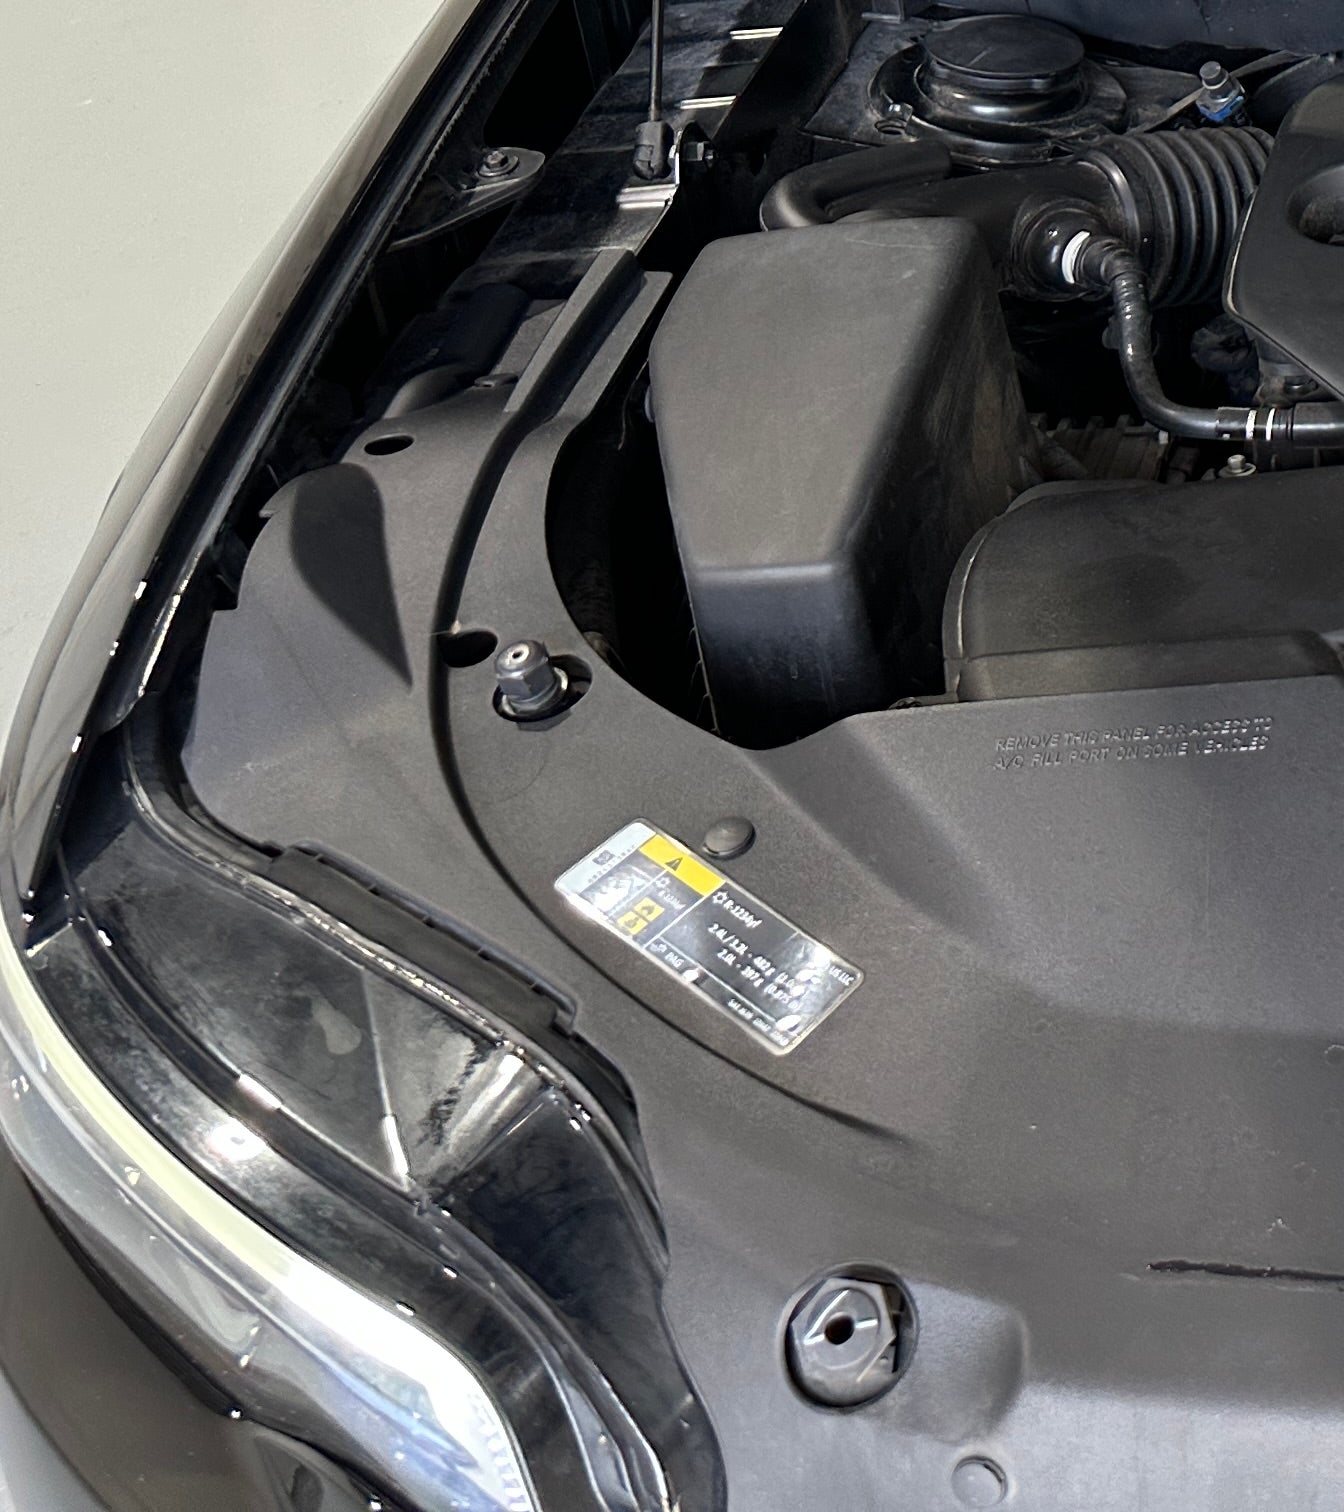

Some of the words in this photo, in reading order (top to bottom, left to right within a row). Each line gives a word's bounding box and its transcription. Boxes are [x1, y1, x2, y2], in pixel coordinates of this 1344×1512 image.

[995, 732, 1060, 751] REMOVE
[1064, 728, 1099, 745] THIS
[1103, 725, 1150, 742] PANEL
[1155, 723, 1187, 739] FOR
[1189, 718, 1251, 736] ACCESS
[1253, 716, 1273, 732] TO
[1030, 752, 1063, 768] FILL
[1068, 747, 1111, 764] PORT
[1116, 745, 1138, 760] ON
[1144, 741, 1189, 759] SOME
[723, 899, 763, 928] R-1234yf
[664, 952, 685, 968] PAG
